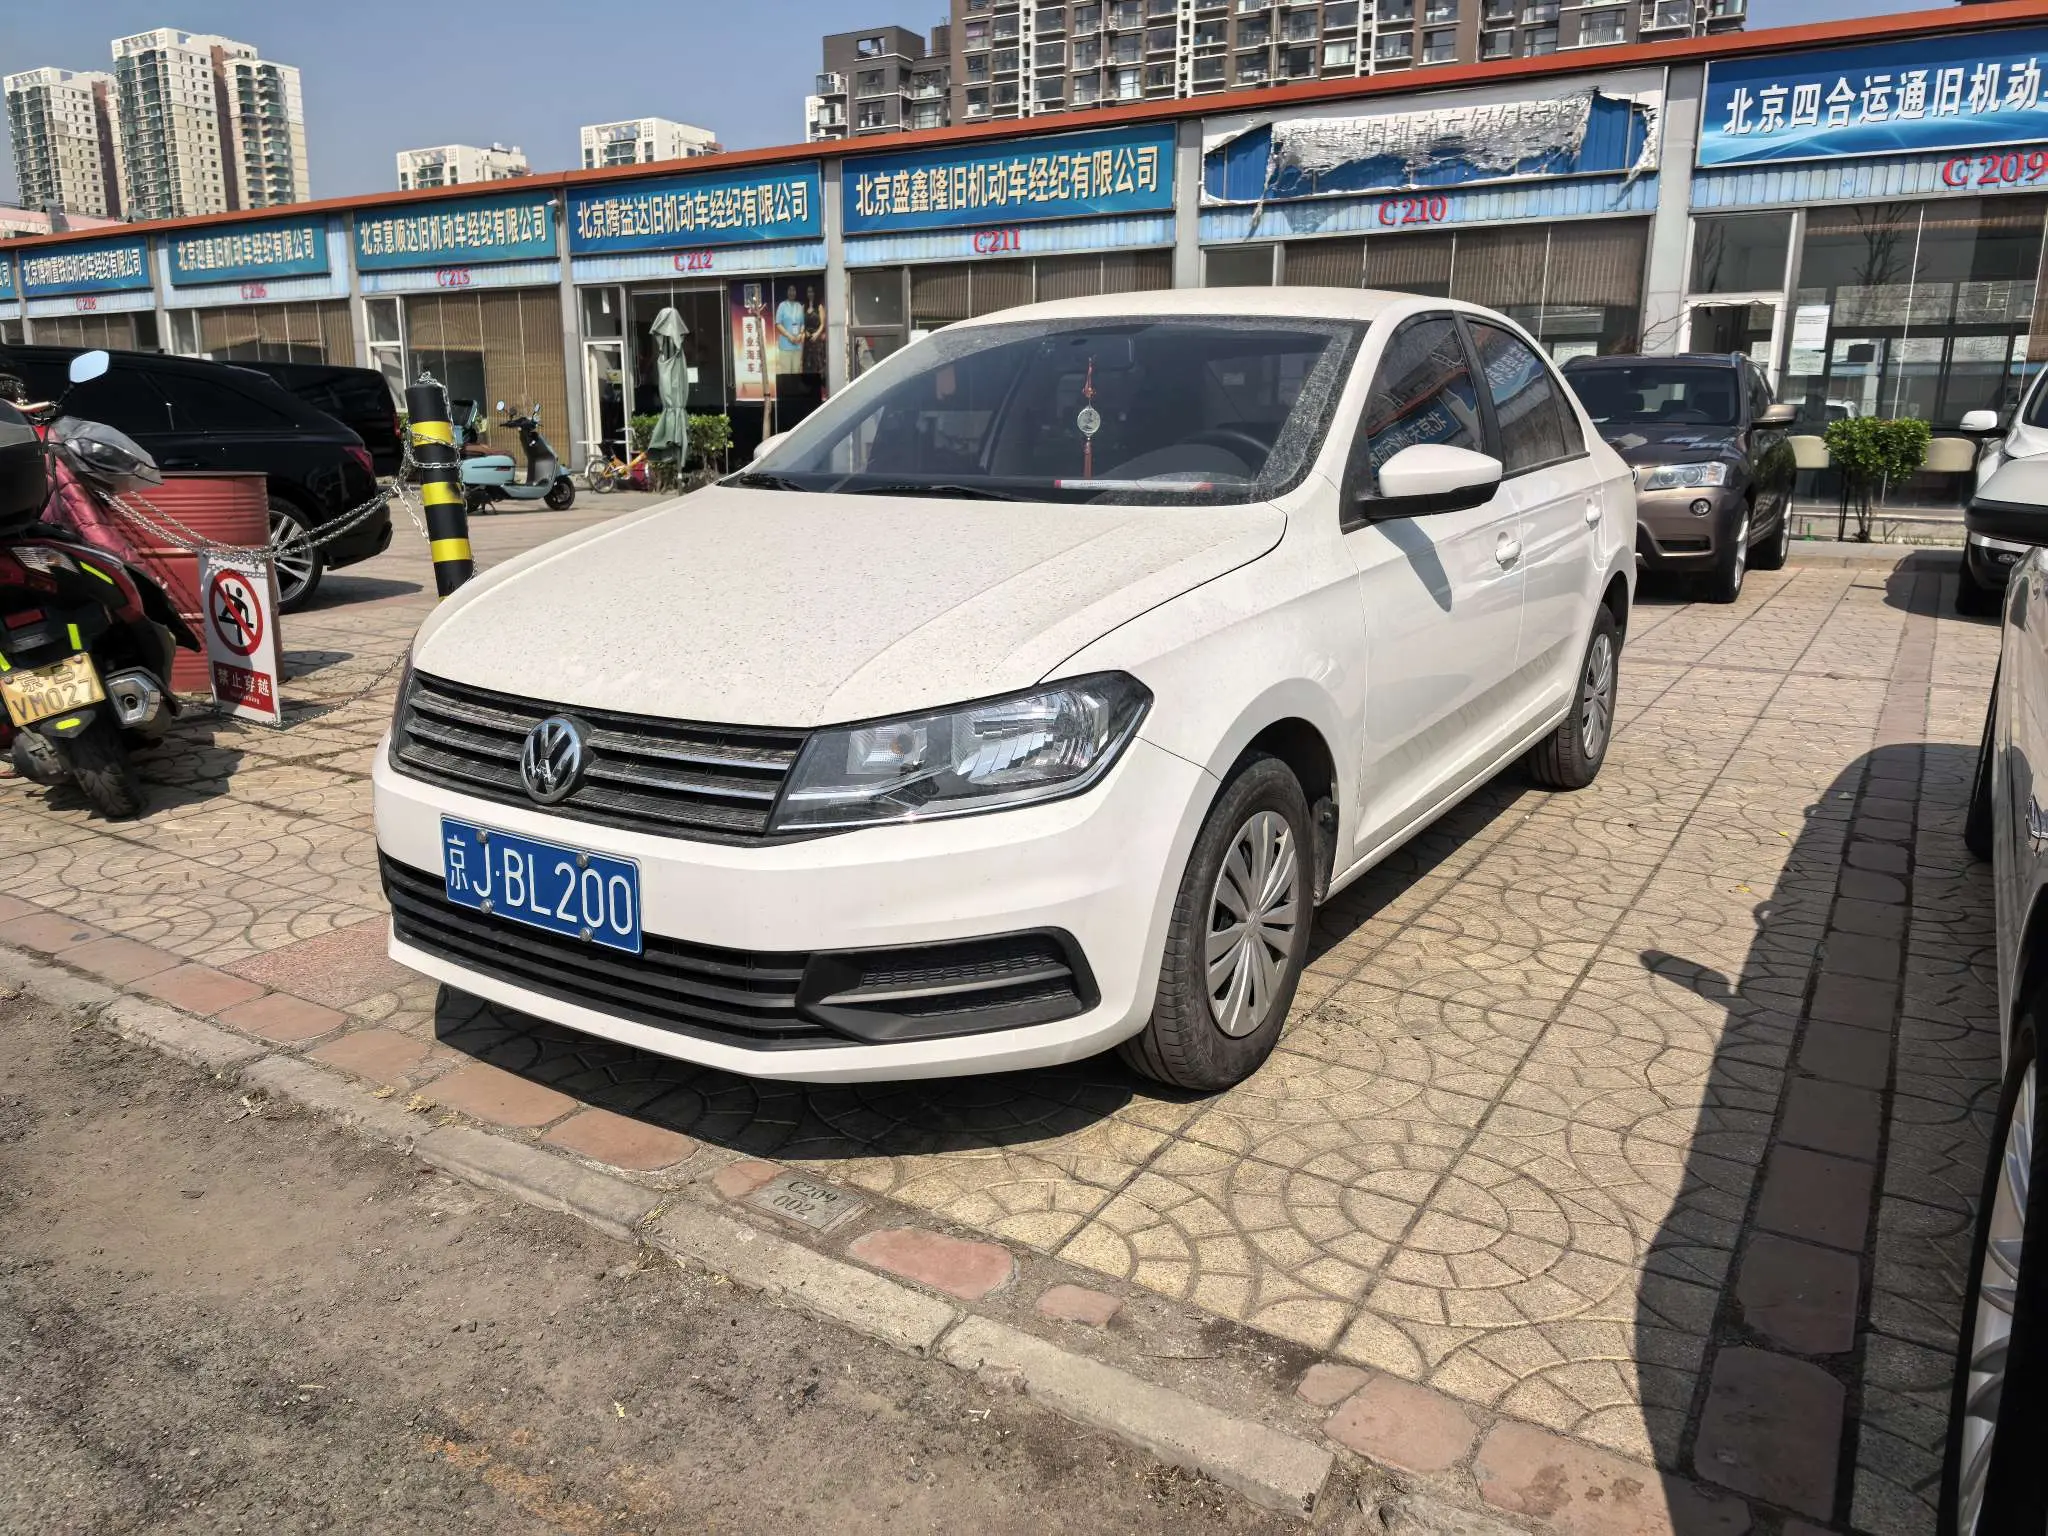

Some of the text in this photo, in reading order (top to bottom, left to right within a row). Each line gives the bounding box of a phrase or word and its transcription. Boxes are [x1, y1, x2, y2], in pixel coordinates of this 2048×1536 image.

[1723, 57, 2048, 135] 北京四合运通旧机动
[217, 667, 271, 697] 禁止穿越
